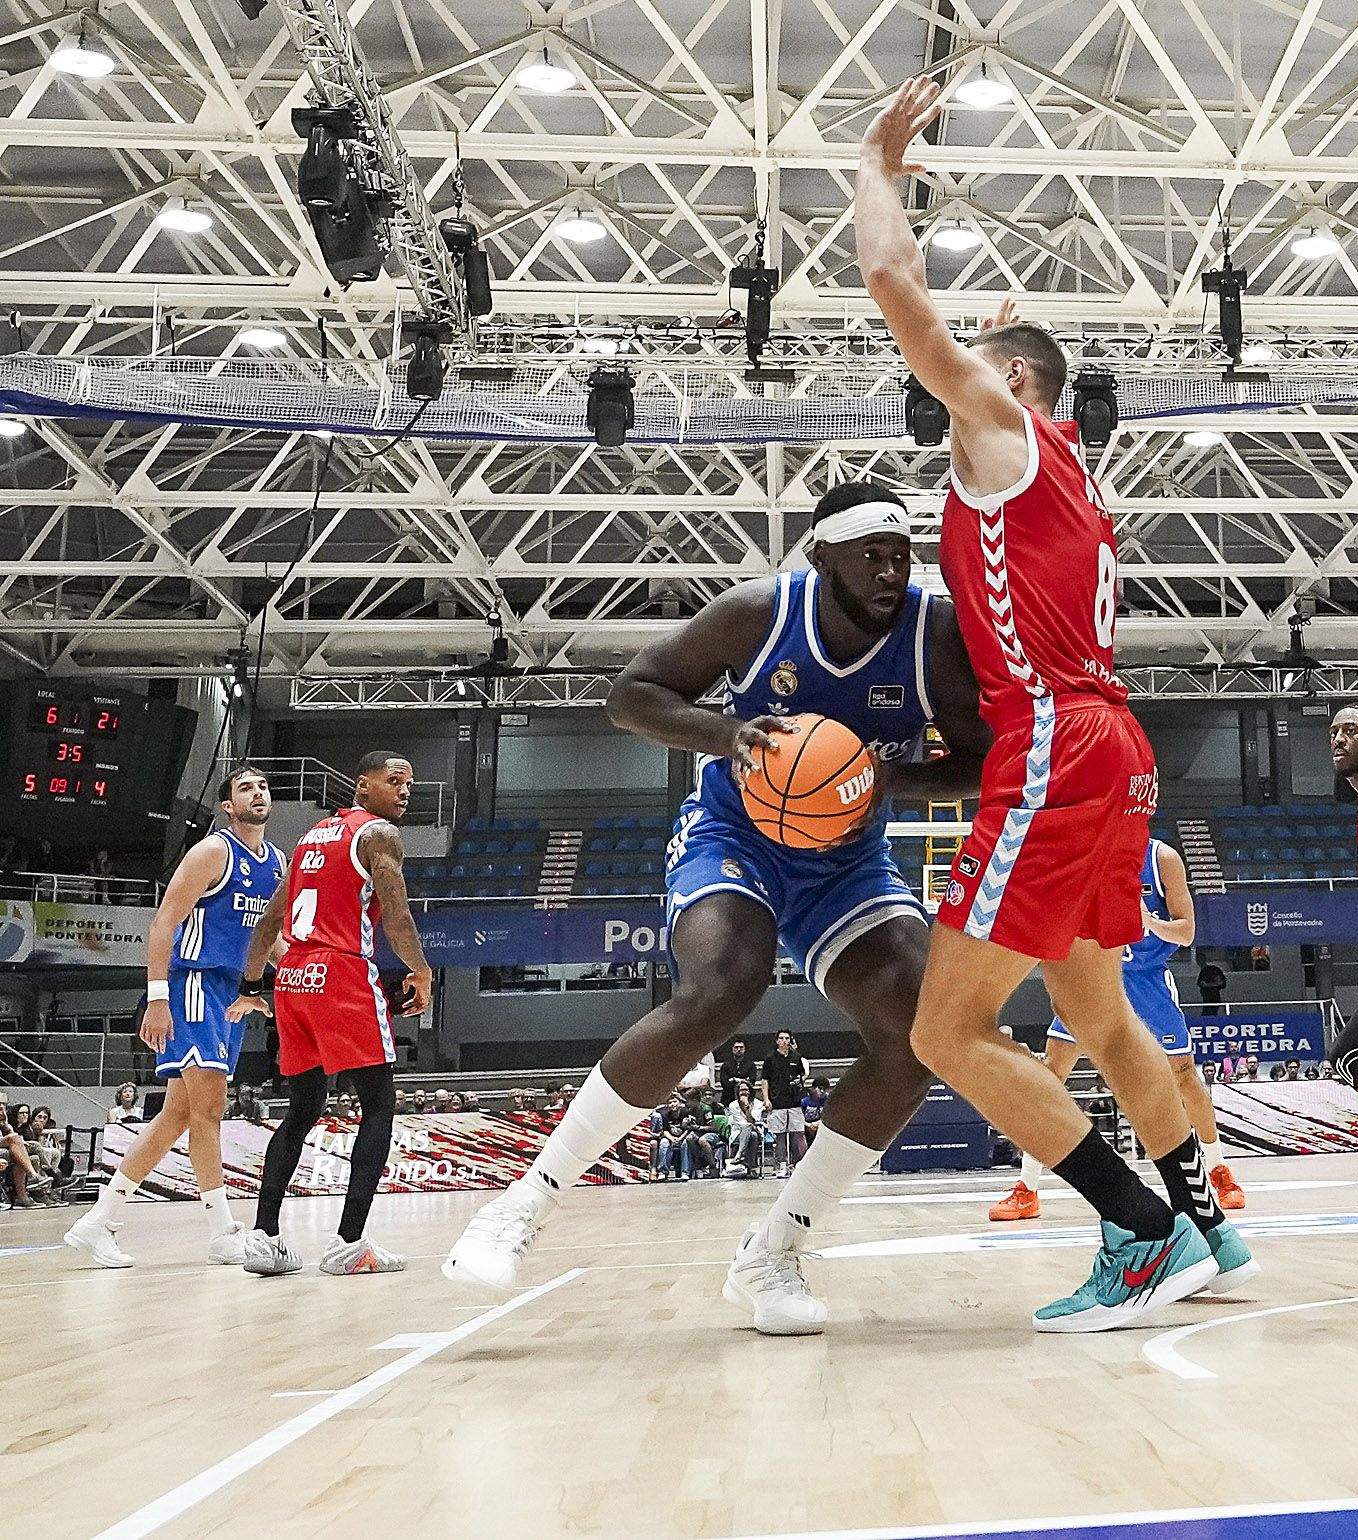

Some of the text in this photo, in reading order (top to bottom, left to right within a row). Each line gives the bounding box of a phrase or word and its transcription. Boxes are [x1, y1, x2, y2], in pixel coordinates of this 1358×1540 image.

[1094, 542, 1117, 649] 8
[46, 707, 58, 725] 6
[24, 774, 36, 793] 5
[94, 781, 106, 796] 4
[299, 850, 325, 870] Rio
[290, 887, 318, 941] 4
[1272, 911, 1303, 920] Concello
[45, 918, 114, 930] DEPORTE
[1283, 919, 1324, 927] Pontevedra
[45, 931, 144, 944] PONTEVEDRA
[1191, 1023, 1285, 1039] EPORTE
